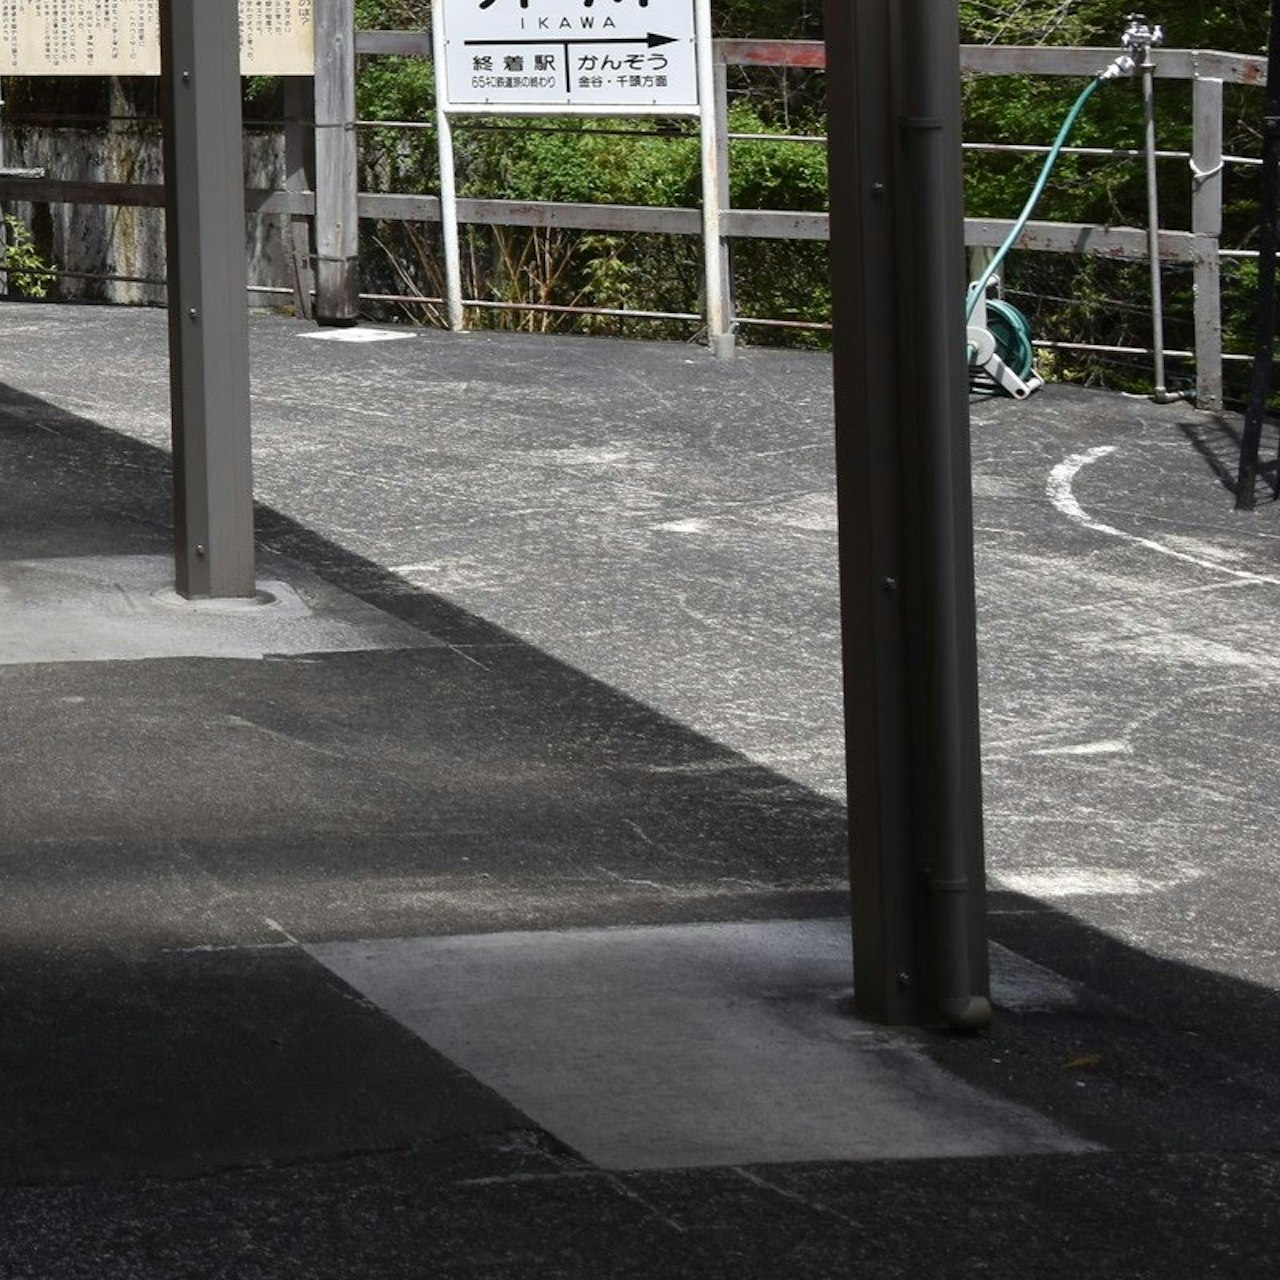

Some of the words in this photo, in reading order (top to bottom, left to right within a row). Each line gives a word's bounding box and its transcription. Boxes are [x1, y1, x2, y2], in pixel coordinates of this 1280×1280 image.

[520, 16, 616, 30] IKAWA
[472, 54, 556, 72] 終着駅
[577, 53, 668, 70] かんぞう
[578, 74, 668, 89] 金谷・千頭方面
